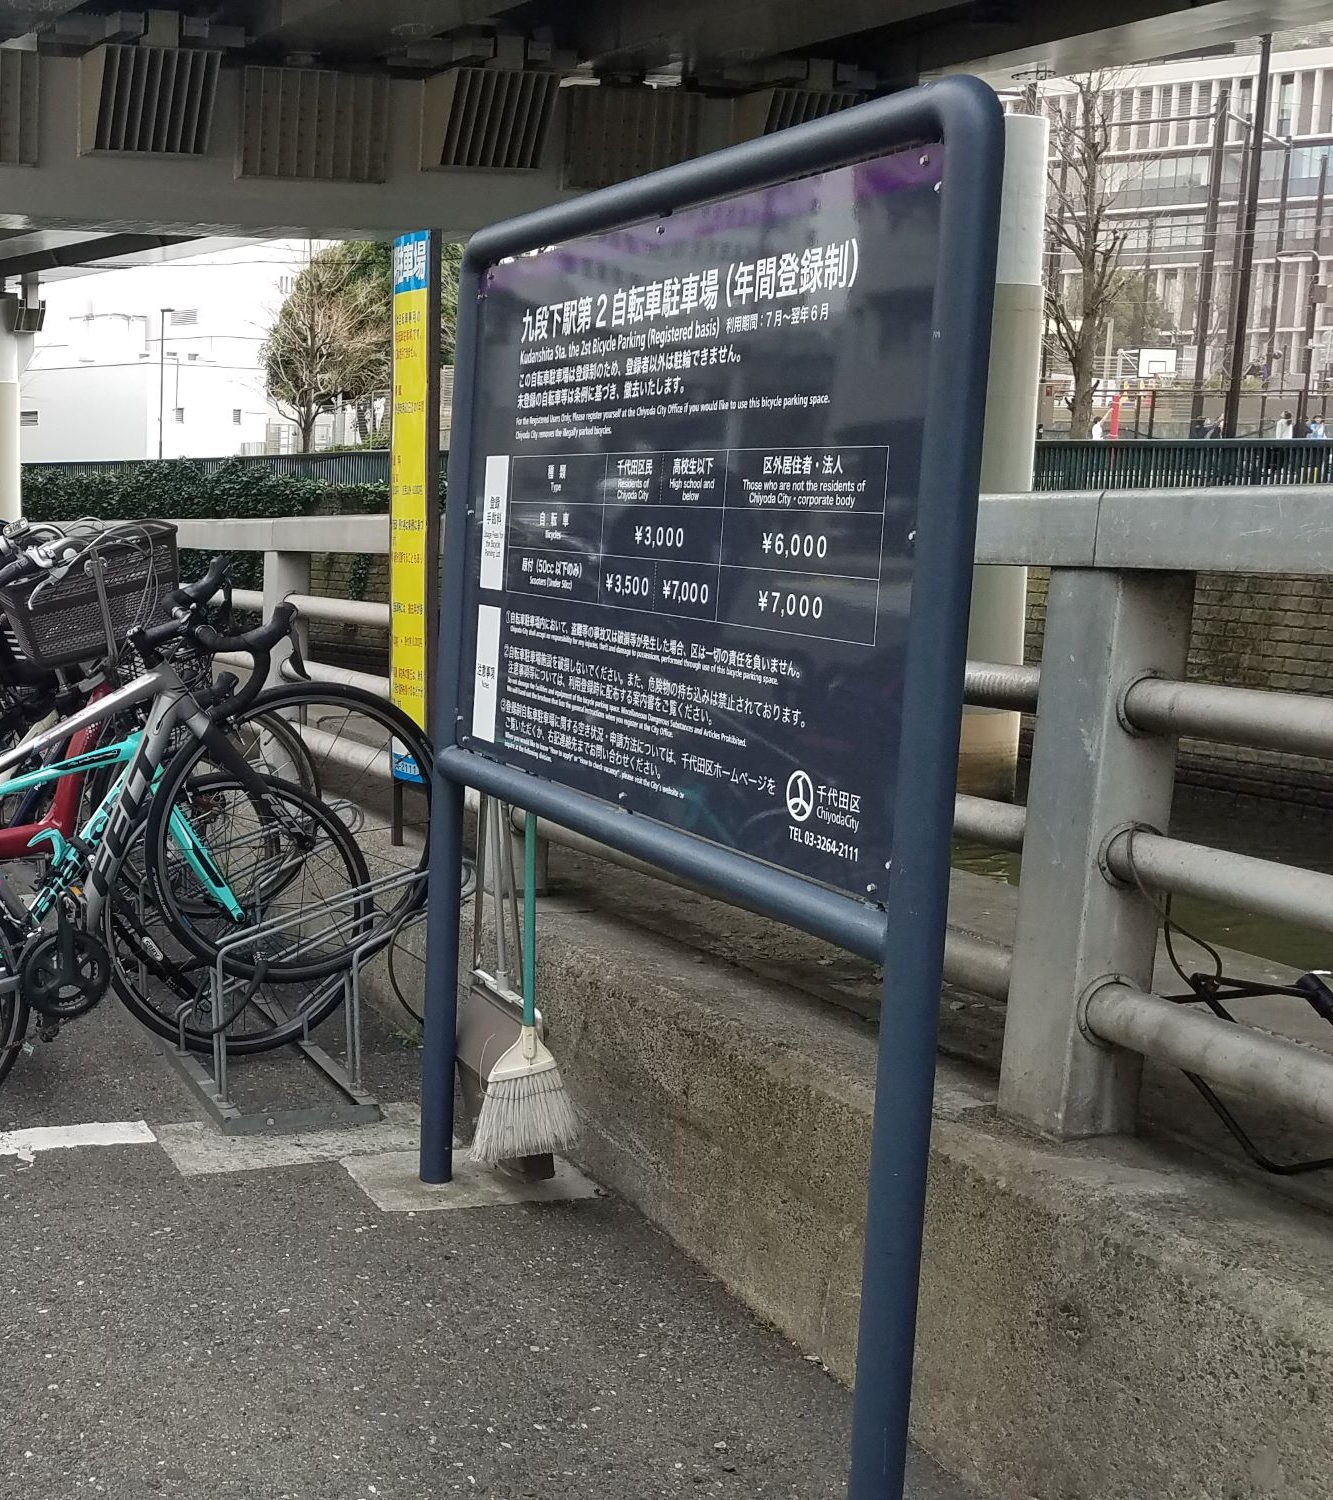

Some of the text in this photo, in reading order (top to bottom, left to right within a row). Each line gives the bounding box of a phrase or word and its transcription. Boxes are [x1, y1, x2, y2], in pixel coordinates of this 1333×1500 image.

[554, 342, 567, 359] Sta.
[568, 339, 580, 357] the
[592, 333, 617, 357] Bicycle
[617, 329, 646, 354] Parking
[647, 321, 693, 349] (Registered
[693, 317, 720, 343] basis)
[585, 410, 602, 423] register
[602, 409, 621, 421] yourself
[621, 408, 627, 418] at
[627, 408, 635, 418] the
[636, 406, 656, 419] Chiyoda
[656, 405, 666, 418] City
[667, 404, 683, 415] Office
[683, 404, 688, 414] if
[688, 405, 699, 416] you
[699, 401, 718, 413] would
[718, 400, 729, 412] like
[729, 400, 736, 411] to
[737, 401, 748, 410] use
[748, 398, 760, 409] this
[760, 396, 782, 411] bicycle
[782, 394, 808, 410] parking
[808, 395, 831, 408] space.
[616, 458, 653, 476] 千代田区民
[672, 456, 714, 475] 高校生以下
[762, 454, 845, 474] 区外居住者・法人
[550, 482, 561, 493] Type
[616, 490, 648, 502] Chiyoda City
[643, 478, 649, 489] of
[669, 478, 715, 492] High school and
[682, 491, 699, 501] below
[742, 479, 866, 491] Those who are not the residents of
[748, 492, 856, 508] Chiyoda City corporate body
[633, 524, 684, 550] ¥3,000
[761, 531, 828, 561] ¥6,000
[604, 571, 649, 598] ¥3,500
[661, 577, 710, 606] ¥7,000
[757, 589, 824, 623] ¥7,000
[816, 785, 862, 814] 千代田区
[91, 734, 155, 898] FELT
[260, 793, 307, 837] FELT
[788, 825, 859, 862] TEL 03-3264-2111
